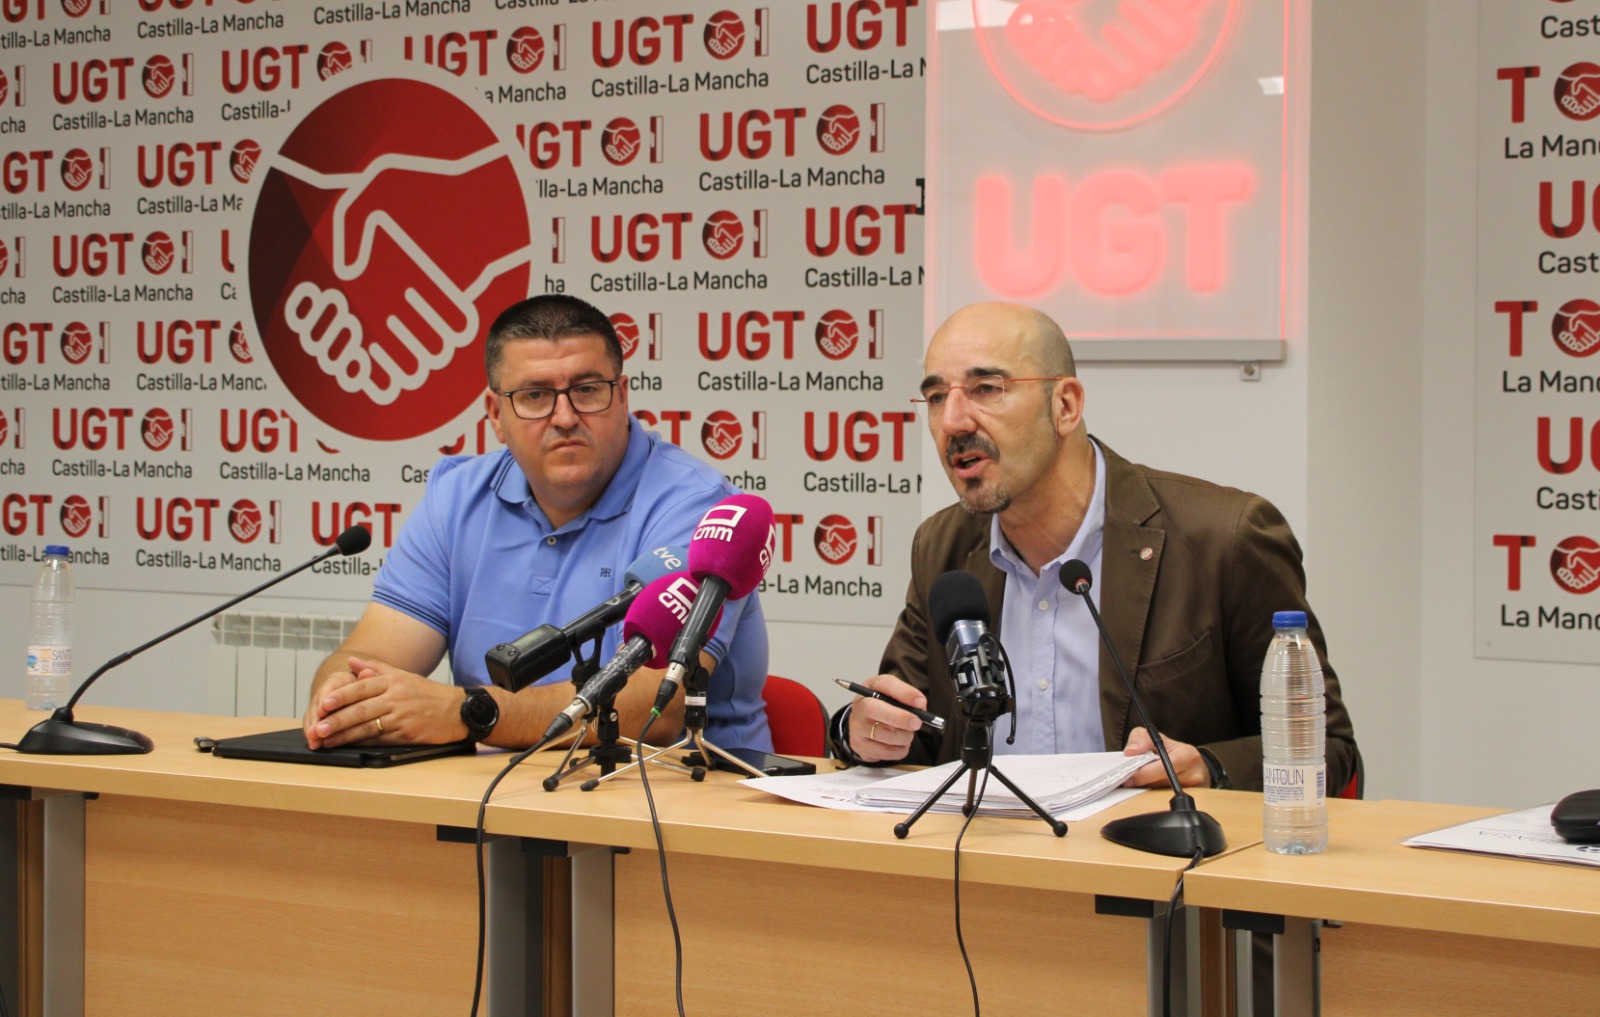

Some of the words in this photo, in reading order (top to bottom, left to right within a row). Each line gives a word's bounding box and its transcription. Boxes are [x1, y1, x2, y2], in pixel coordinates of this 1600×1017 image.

[314, 2, 400, 25] Castilla-La
[406, 0, 470, 17] Mancha
[54, 25, 110, 45] Mancha
[138, 17, 218, 39] Castilla-La
[223, 11, 283, 31] Mancha
[807, 0, 918, 53] UGT
[592, 14, 694, 68] UGT
[222, 45, 309, 93] UGT
[807, 60, 913, 84] Castilla-La
[54, 58, 134, 104] UGT
[499, 82, 566, 103] Mancha
[592, 74, 689, 97] Castilla-La
[695, 68, 768, 90] Mancha
[53, 111, 131, 131] Castilla-La
[135, 106, 193, 125] Mancha
[700, 108, 806, 161] UGT
[1542, 135, 1600, 157] Man
[138, 142, 222, 187] UGT
[535, 179, 588, 198] lla-La
[593, 175, 663, 195] Mancha
[699, 169, 801, 191] Castilla-La
[808, 165, 884, 186] Mancha
[54, 200, 110, 217] Mancha
[138, 196, 218, 214] Castilla-La
[592, 213, 692, 263] UGT
[806, 204, 917, 258] UGT
[974, 164, 1255, 298] UGT
[54, 233, 134, 276] UGT
[591, 272, 688, 292] Castilla-La
[694, 270, 767, 289] Mancha
[805, 267, 911, 287] Castilla-La
[53, 286, 130, 303] Castilla-La
[135, 284, 193, 301] Mancha
[138, 320, 221, 364] UGT
[699, 311, 804, 361] UGT
[54, 374, 110, 390] Mancha
[137, 373, 217, 390] Castilla-La
[222, 373, 267, 390] Manc
[698, 371, 800, 390] Castilla-La
[807, 371, 883, 390] Mancha
[53, 408, 133, 450] UGT
[805, 411, 915, 462] UGT
[52, 459, 130, 477] Castilla-La
[134, 461, 192, 478] Mancha
[220, 462, 303, 480] Castilla-La
[308, 464, 370, 482] Mancha
[725, 470, 766, 491] cha
[804, 472, 910, 493] Castilla-La
[137, 497, 219, 541] UGT
[693, 526, 733, 542] cmm
[65, 547, 110, 565] ancha
[136, 549, 216, 569] Castilla-La
[221, 553, 281, 572] Mancha
[654, 547, 682, 570] tve
[805, 575, 882, 597] Mancha
[658, 592, 690, 624] cm
[1264, 768, 1304, 785] ANTOLIN
